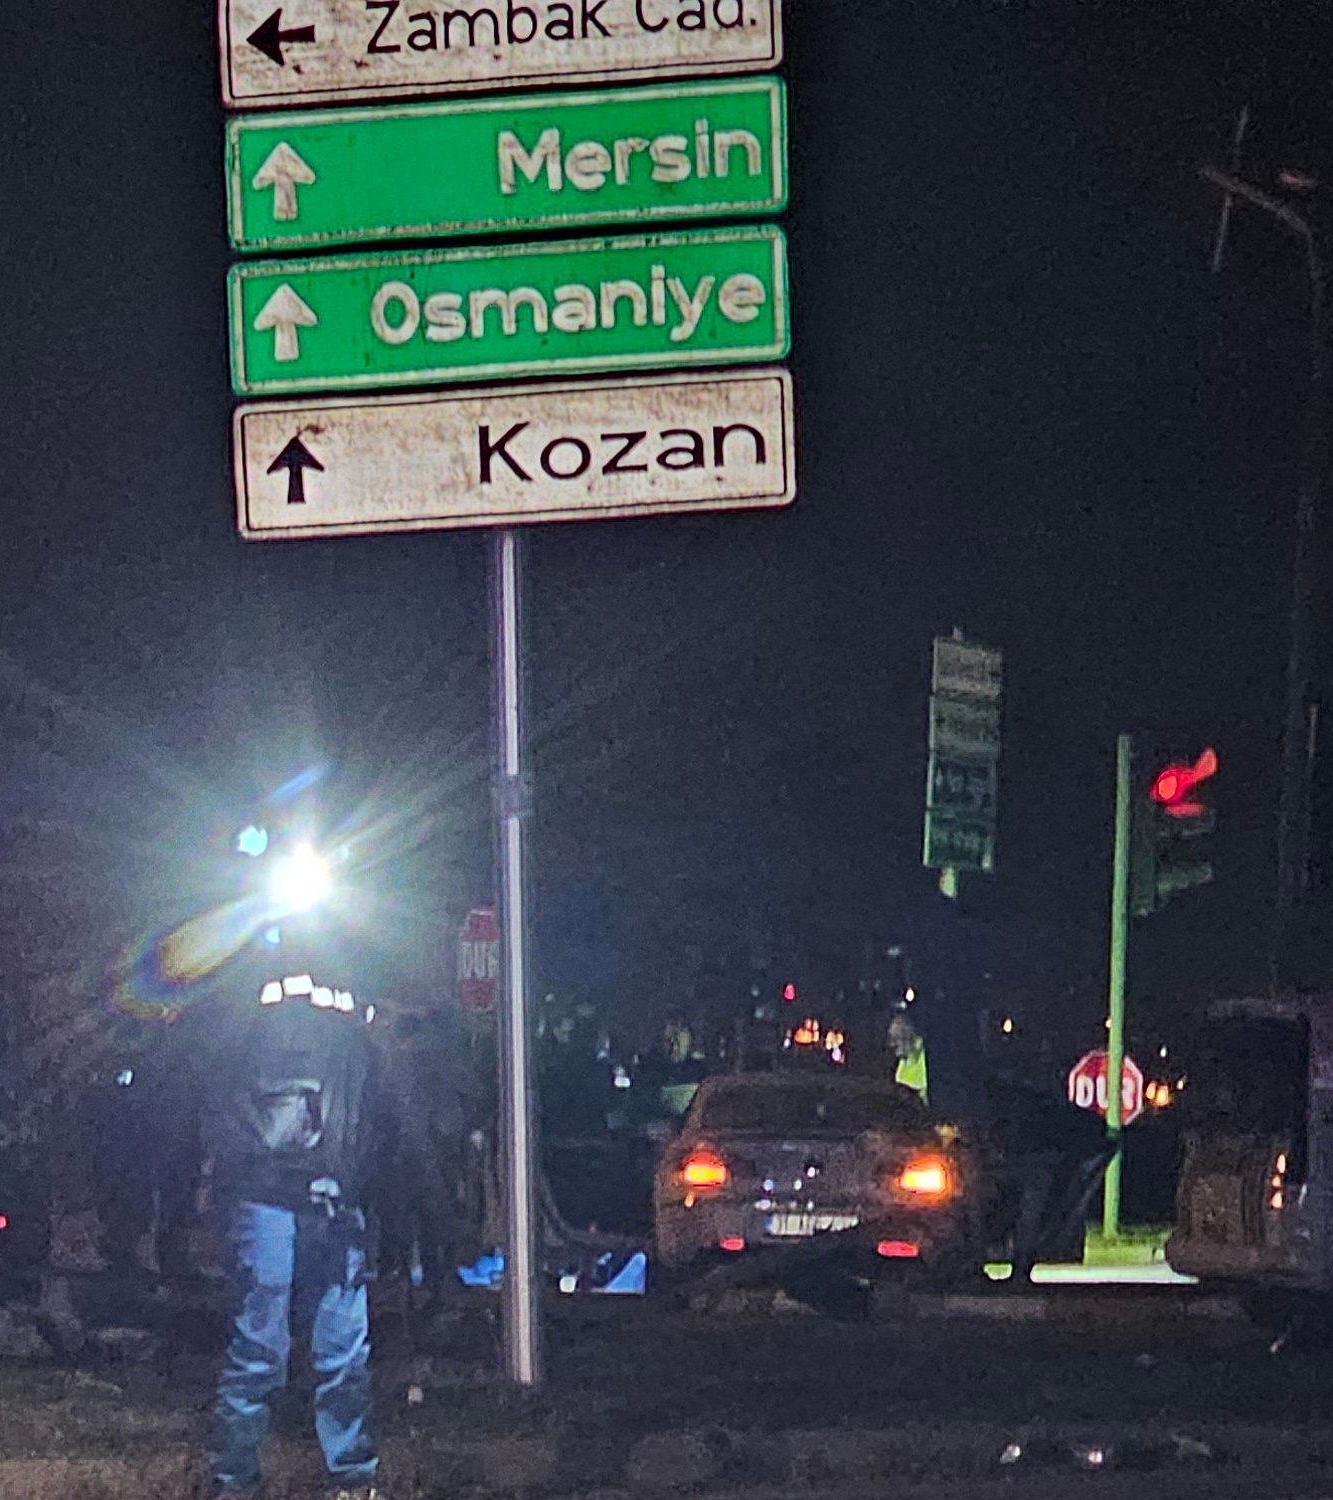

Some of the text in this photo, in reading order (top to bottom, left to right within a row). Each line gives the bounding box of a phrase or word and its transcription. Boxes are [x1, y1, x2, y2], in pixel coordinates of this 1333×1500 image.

[365, 0, 611, 54] Zambak
[498, 119, 762, 195] Mersin
[371, 264, 766, 345] Osmaniye
[478, 421, 767, 484] Kozan
